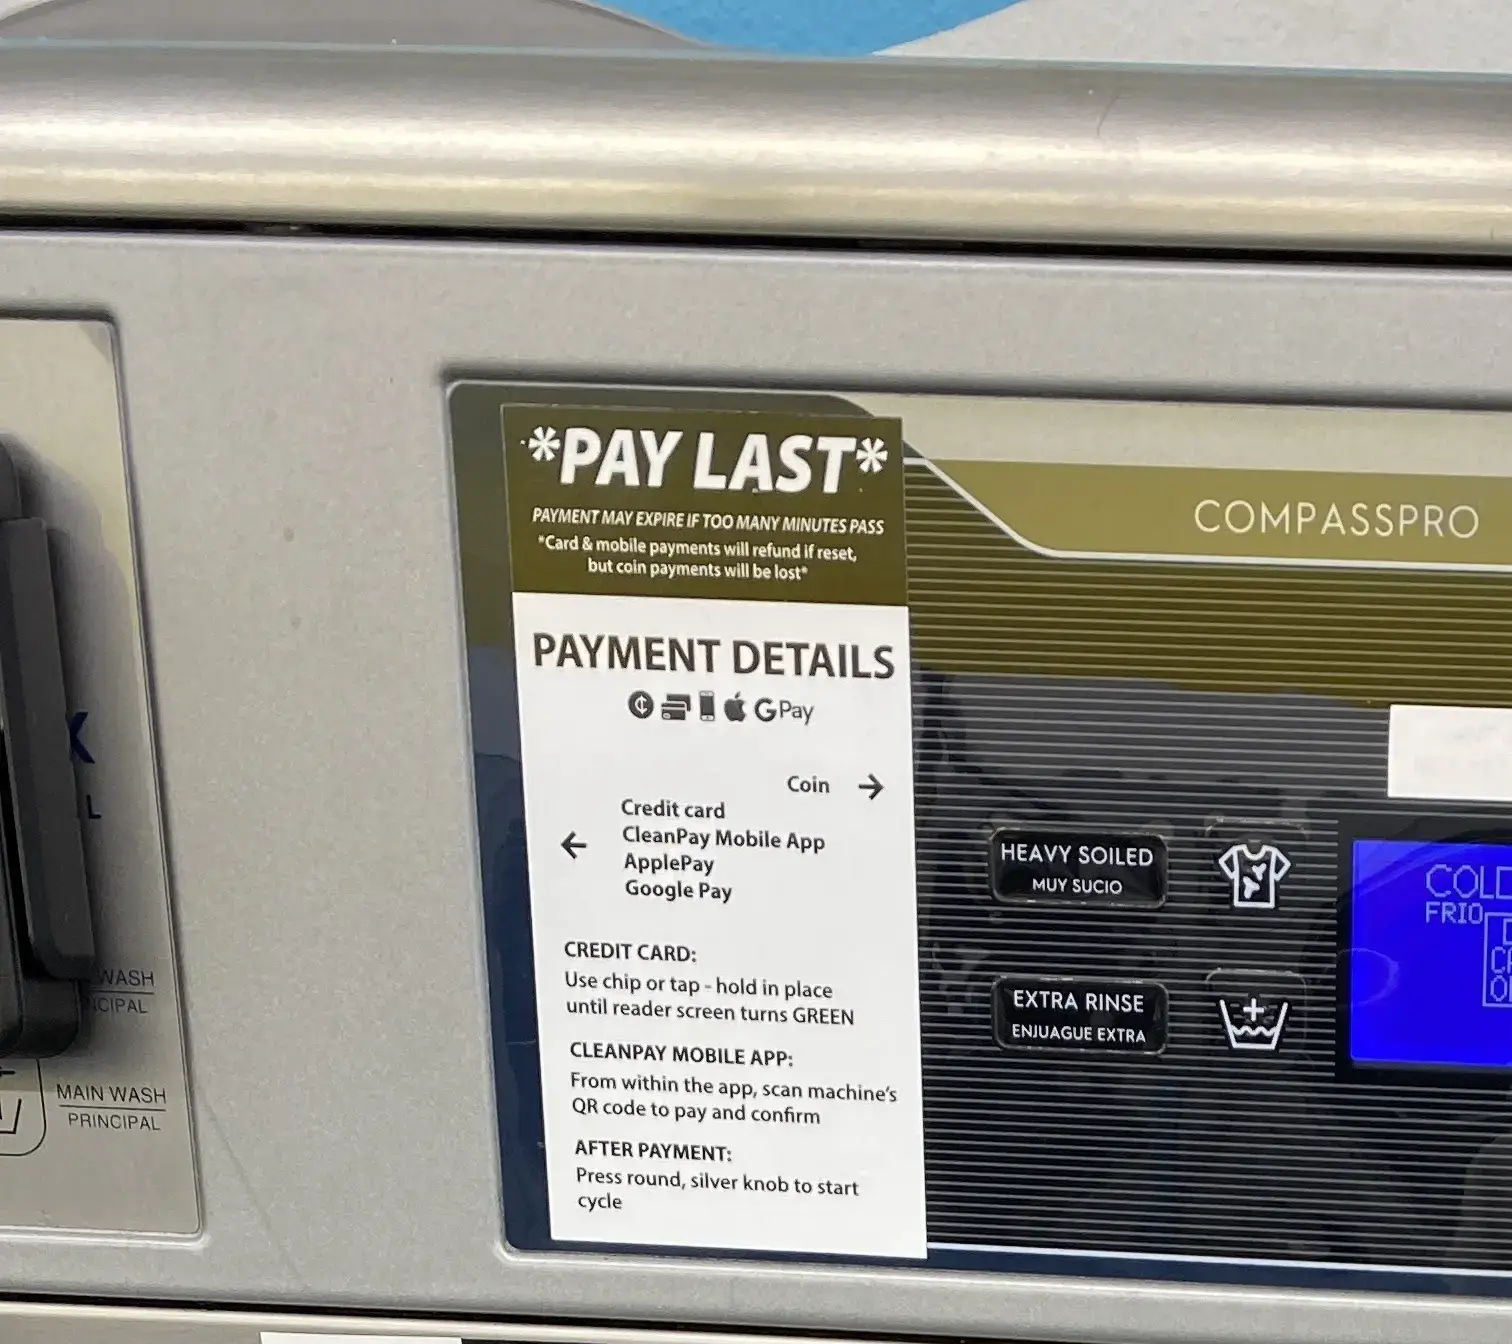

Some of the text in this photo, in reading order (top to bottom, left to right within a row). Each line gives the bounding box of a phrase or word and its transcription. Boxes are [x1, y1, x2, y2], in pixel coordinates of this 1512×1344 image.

[533, 508, 884, 534] PAYMENT MAY EXPIRE IF TOO MANY MINUTES PASS
[1194, 499, 1479, 539] COMPASSPRO
[582, 536, 593, 550] &
[596, 537, 646, 553] mobile
[650, 542, 720, 557] payments
[724, 542, 749, 556] will
[753, 542, 800, 558] refund
[804, 544, 814, 558] if
[818, 547, 856, 562] reset,
[588, 558, 613, 573] but
[616, 559, 646, 574] coin
[650, 564, 721, 578] payments
[724, 563, 749, 578] will
[753, 563, 771, 578] be
[534, 633, 894, 679] PAYMENT DETAILS
[788, 776, 829, 793] Coin
[622, 799, 725, 818] Credit card
[623, 826, 825, 854] CleanPay Mobile App
[624, 853, 714, 876] ApplePay
[1001, 843, 1154, 867] HEAVY SOILED
[626, 880, 732, 904] Google Pay
[1032, 878, 1123, 894] MUY SUCIO
[1426, 901, 1483, 925] FRIO
[565, 942, 696, 962] CREDIT CARD:
[565, 972, 832, 1000] Use chip or tap hold in place
[567, 998, 854, 1025] until reader screen turns GREEN
[1013, 989, 1144, 1013] EXTRA RINSE
[1012, 1023, 1146, 1043] ENJUAGUE EXTRA
[570, 1042, 792, 1066] CLEANPAY MOBILE APP:
[56, 1083, 166, 1104] MAIN WASH
[571, 1072, 616, 1089] From
[622, 1075, 678, 1092] within
[684, 1076, 713, 1093] the
[719, 1083, 757, 1099] app,
[763, 1085, 802, 1097] scan
[68, 1112, 161, 1131] PRINCIPAL
[572, 1098, 820, 1124] QR code to pay and confirm
[576, 1140, 731, 1162] AFTER PAYMENT:
[577, 1167, 858, 1196] Press round, silver knob to start
[578, 1193, 622, 1212] cycle
